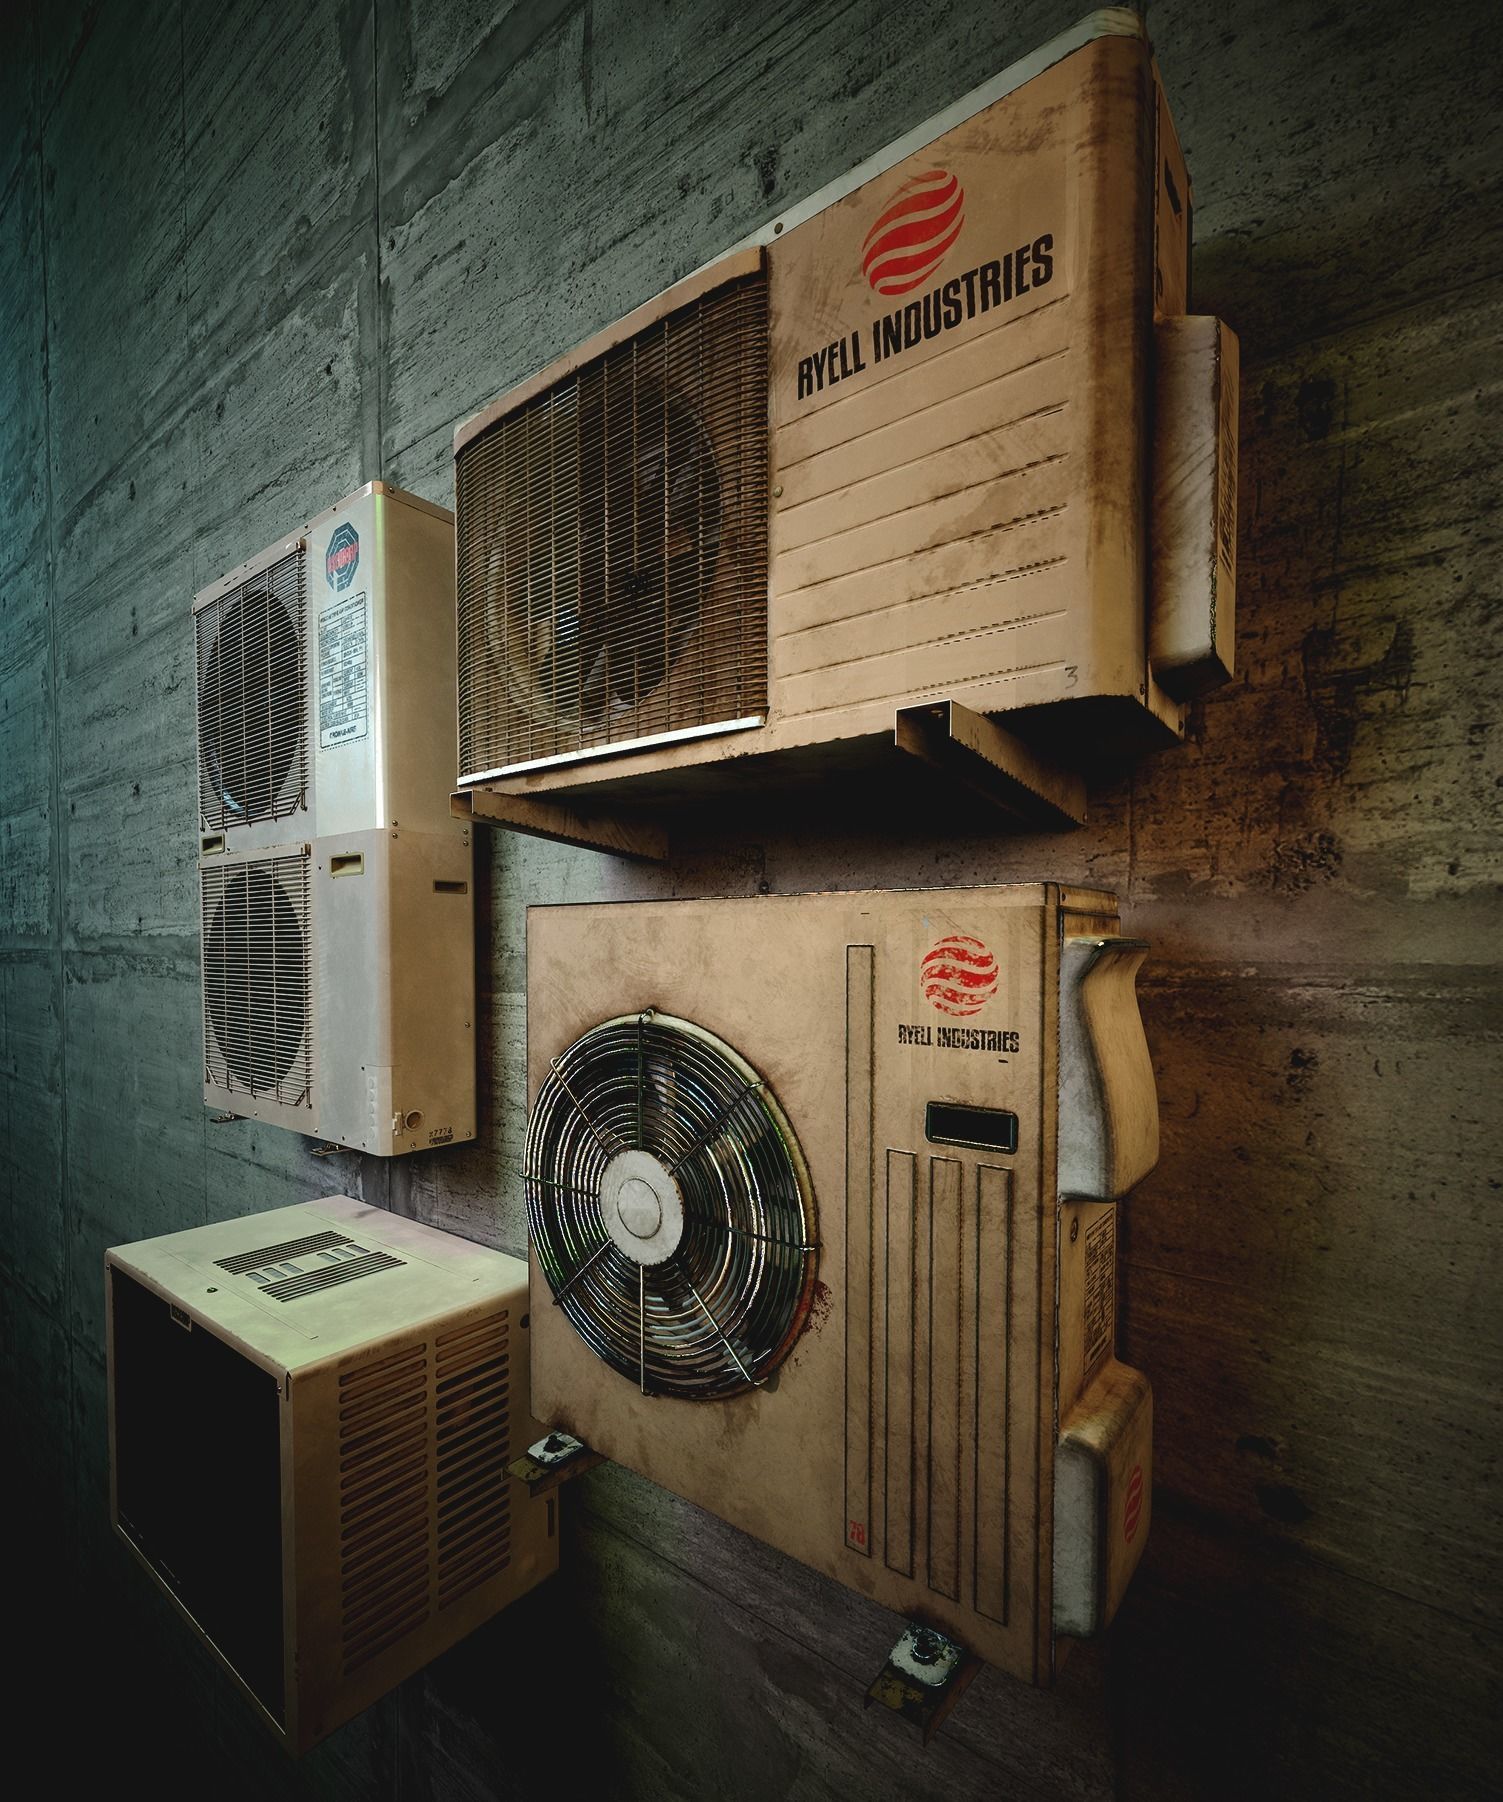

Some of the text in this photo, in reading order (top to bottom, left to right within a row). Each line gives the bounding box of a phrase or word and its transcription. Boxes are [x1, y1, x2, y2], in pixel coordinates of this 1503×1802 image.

[797, 233, 1054, 401] RYELL INDUSTRIES
[1064, 665, 1079, 690] 3
[937, 1026, 1020, 1053] INDUSTRIES
